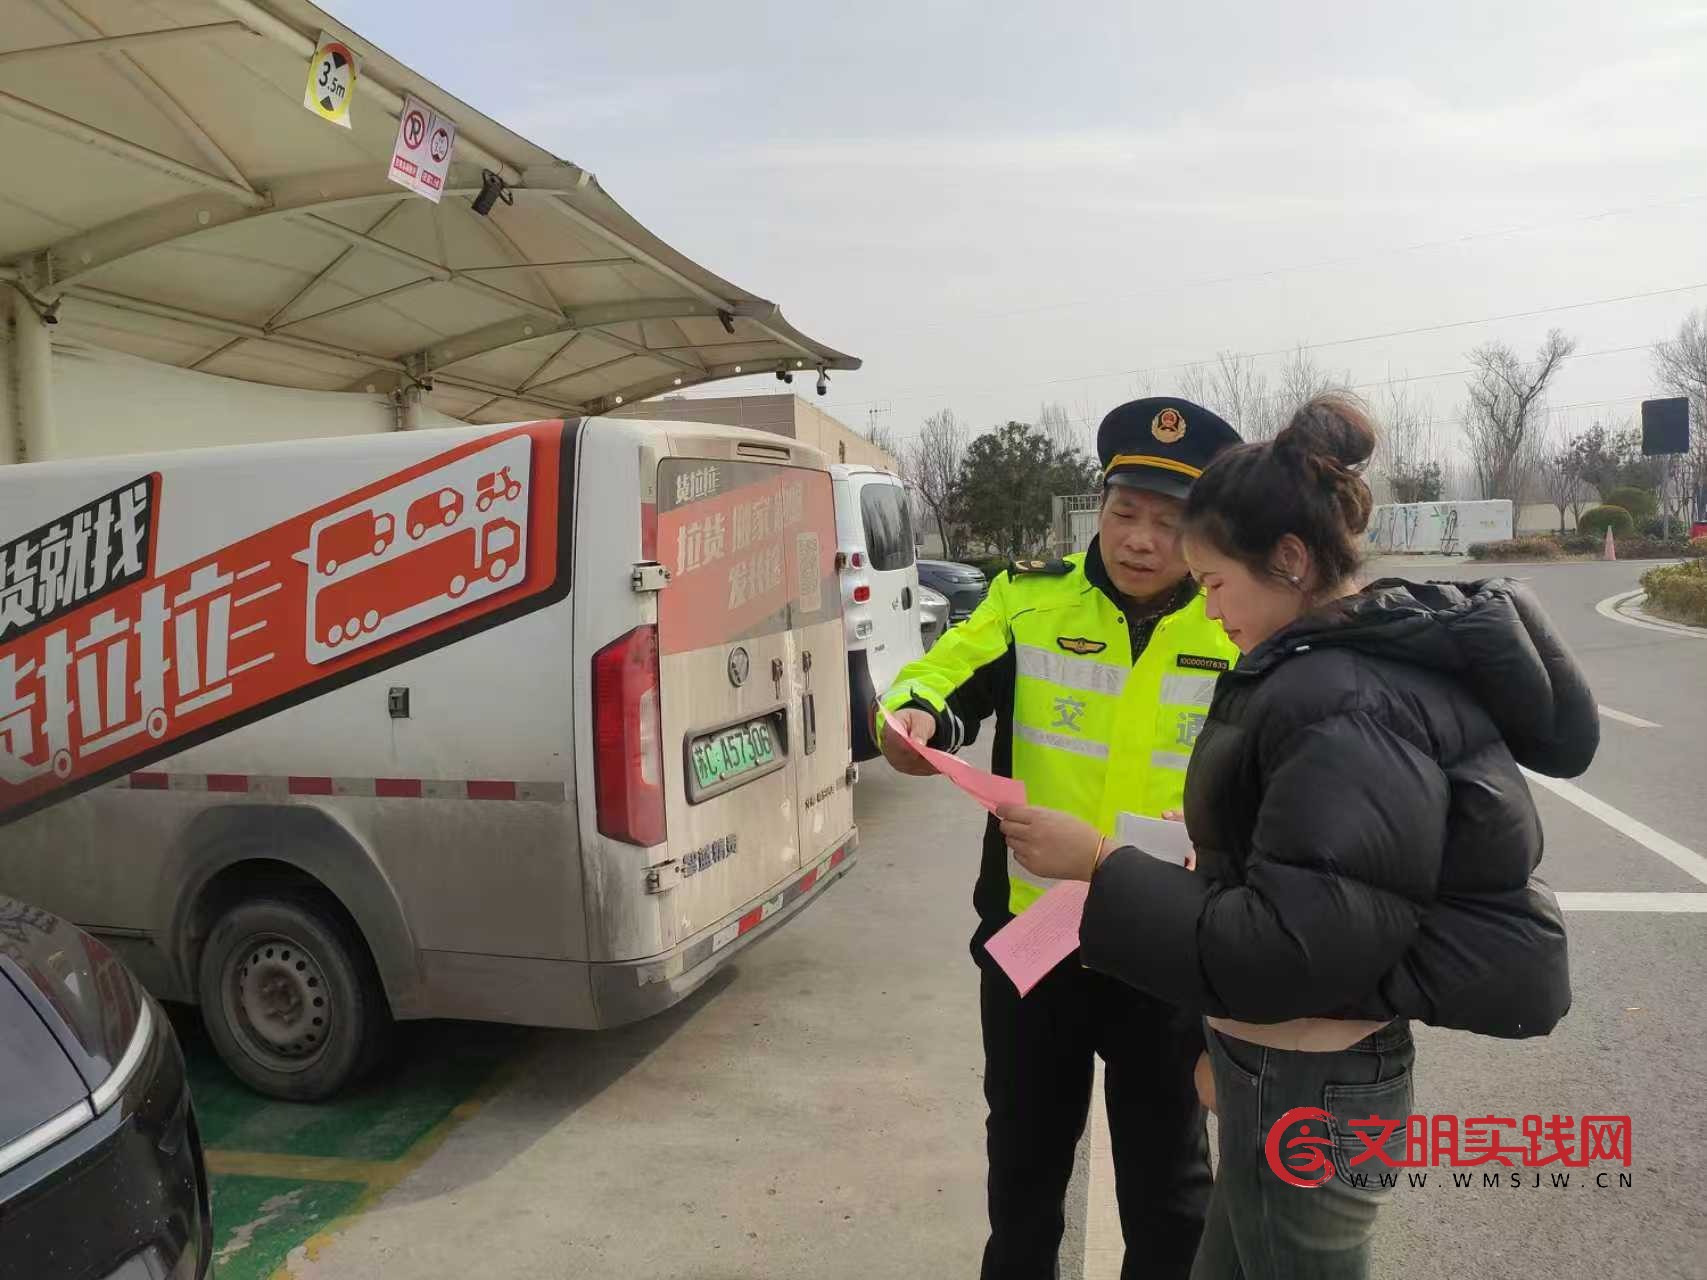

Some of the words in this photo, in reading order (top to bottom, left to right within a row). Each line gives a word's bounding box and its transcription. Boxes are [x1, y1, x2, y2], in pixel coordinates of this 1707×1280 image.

[318, 61, 346, 99] 3.5m
[676, 466, 720, 504] 货拉拉
[676, 513, 726, 576] 拉货
[1052, 696, 1086, 731] 交
